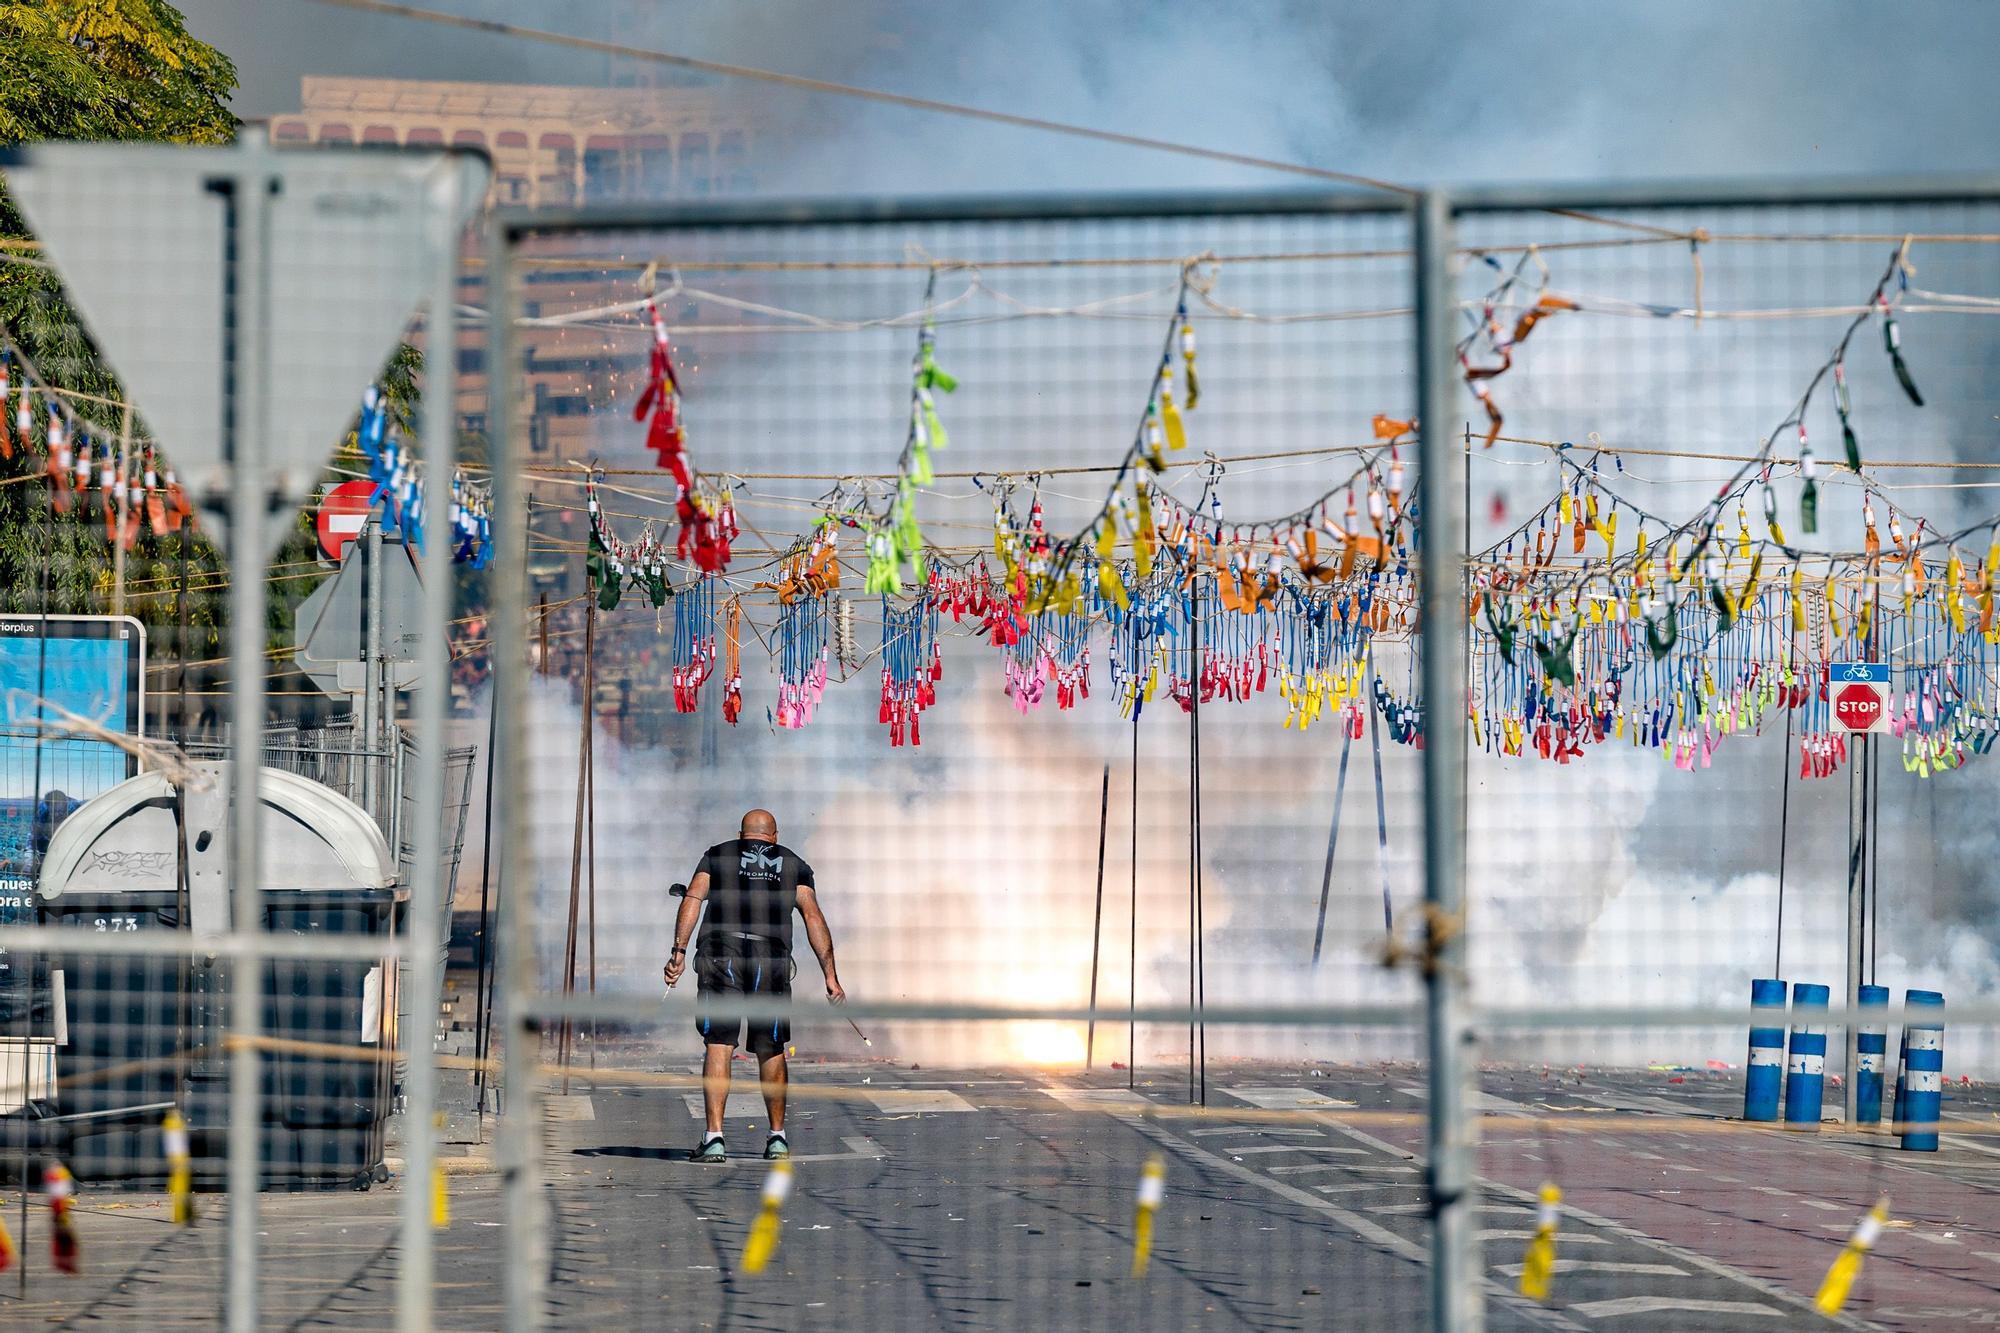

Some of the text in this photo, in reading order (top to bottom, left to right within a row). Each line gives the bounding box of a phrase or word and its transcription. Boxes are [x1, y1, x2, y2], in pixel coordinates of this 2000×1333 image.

[0, 622, 34, 633] iorplus
[1839, 701, 1879, 713] STOP
[740, 851, 783, 873] PM
